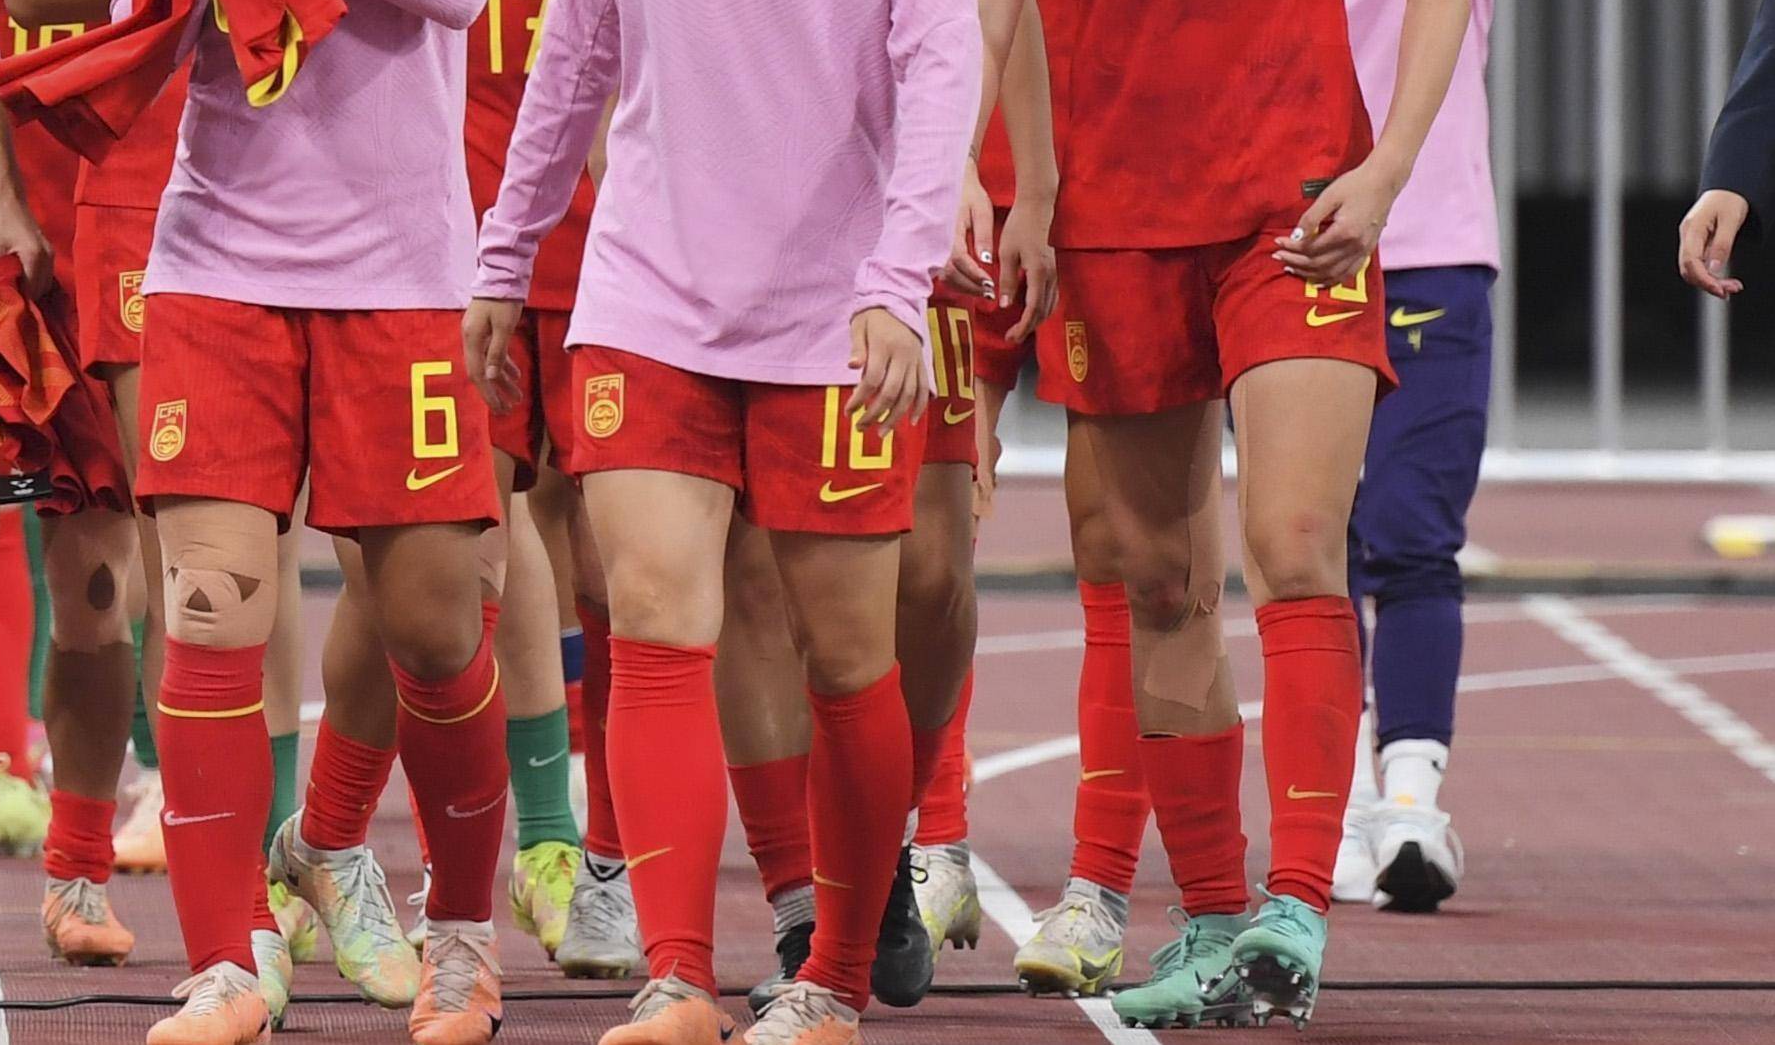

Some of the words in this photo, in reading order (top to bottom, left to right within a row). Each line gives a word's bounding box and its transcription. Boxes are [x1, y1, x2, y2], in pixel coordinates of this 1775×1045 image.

[927, 307, 975, 401] 10
[159, 405, 184, 419] CFA
[411, 361, 460, 459] 6
